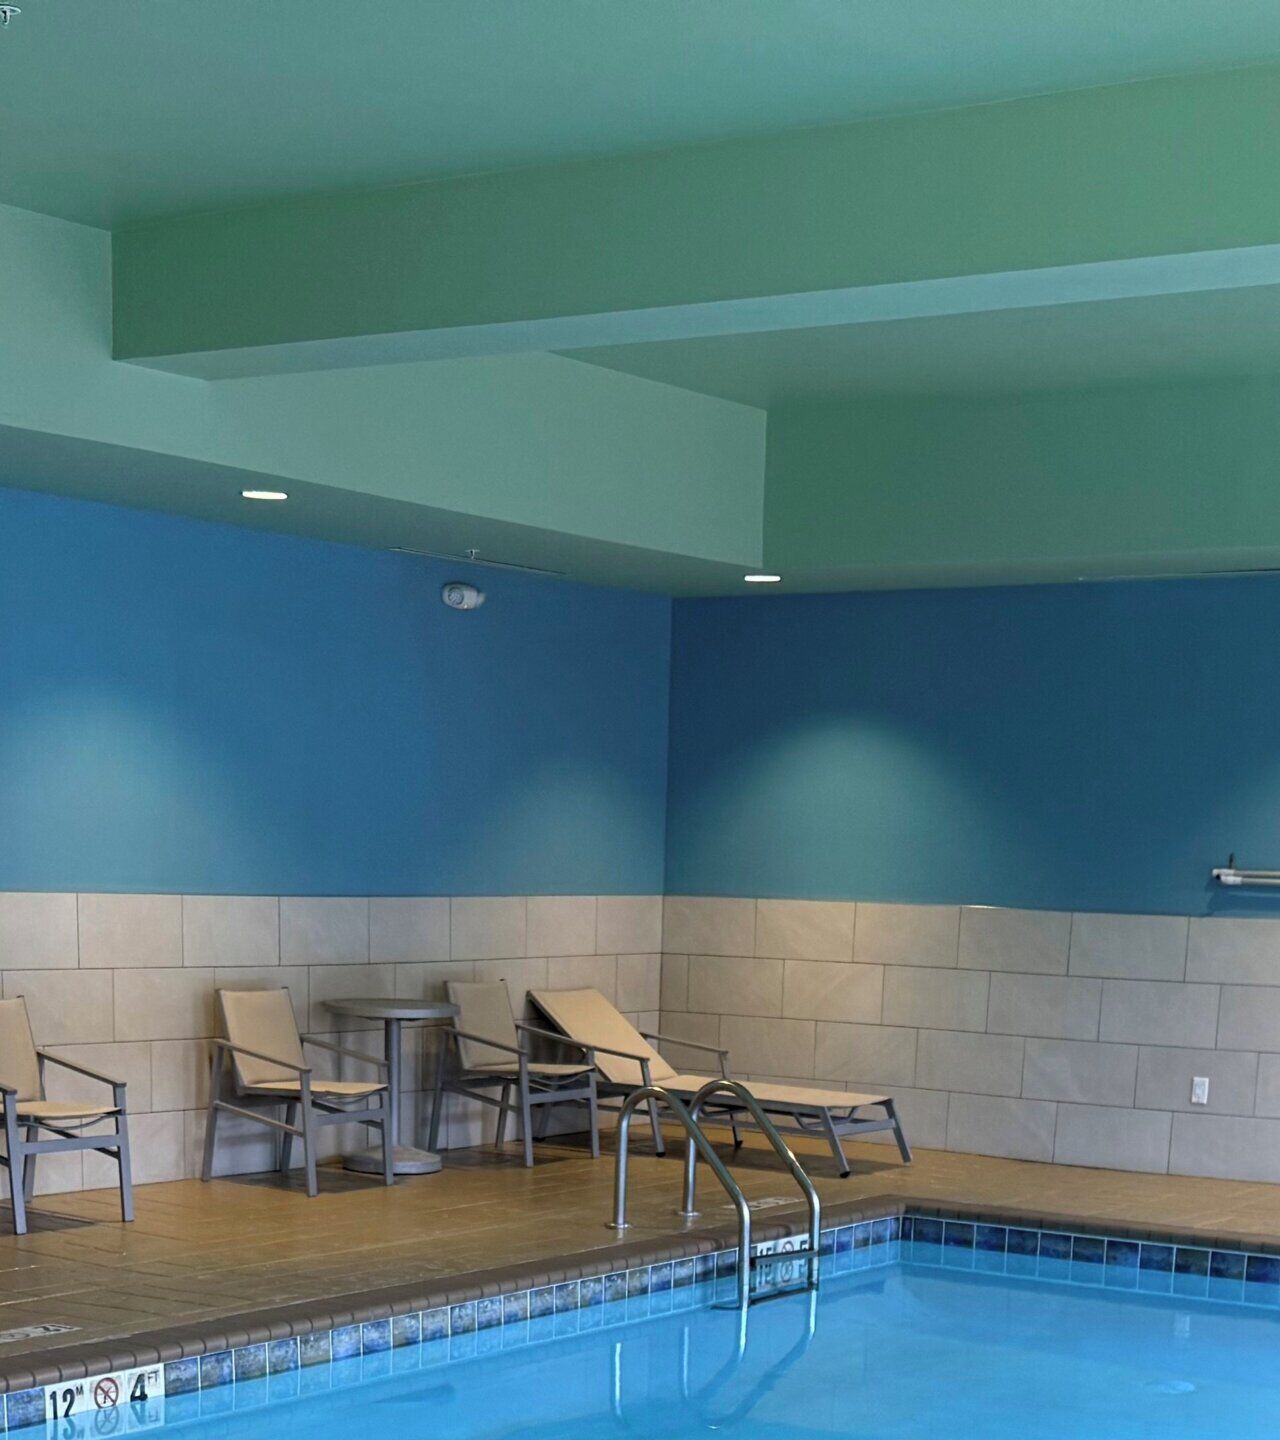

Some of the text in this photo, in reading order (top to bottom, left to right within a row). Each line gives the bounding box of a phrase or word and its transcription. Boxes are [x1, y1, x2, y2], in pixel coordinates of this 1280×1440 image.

[130, 1370, 160, 1403] 4 FT
[49, 1388, 76, 1420] 12
